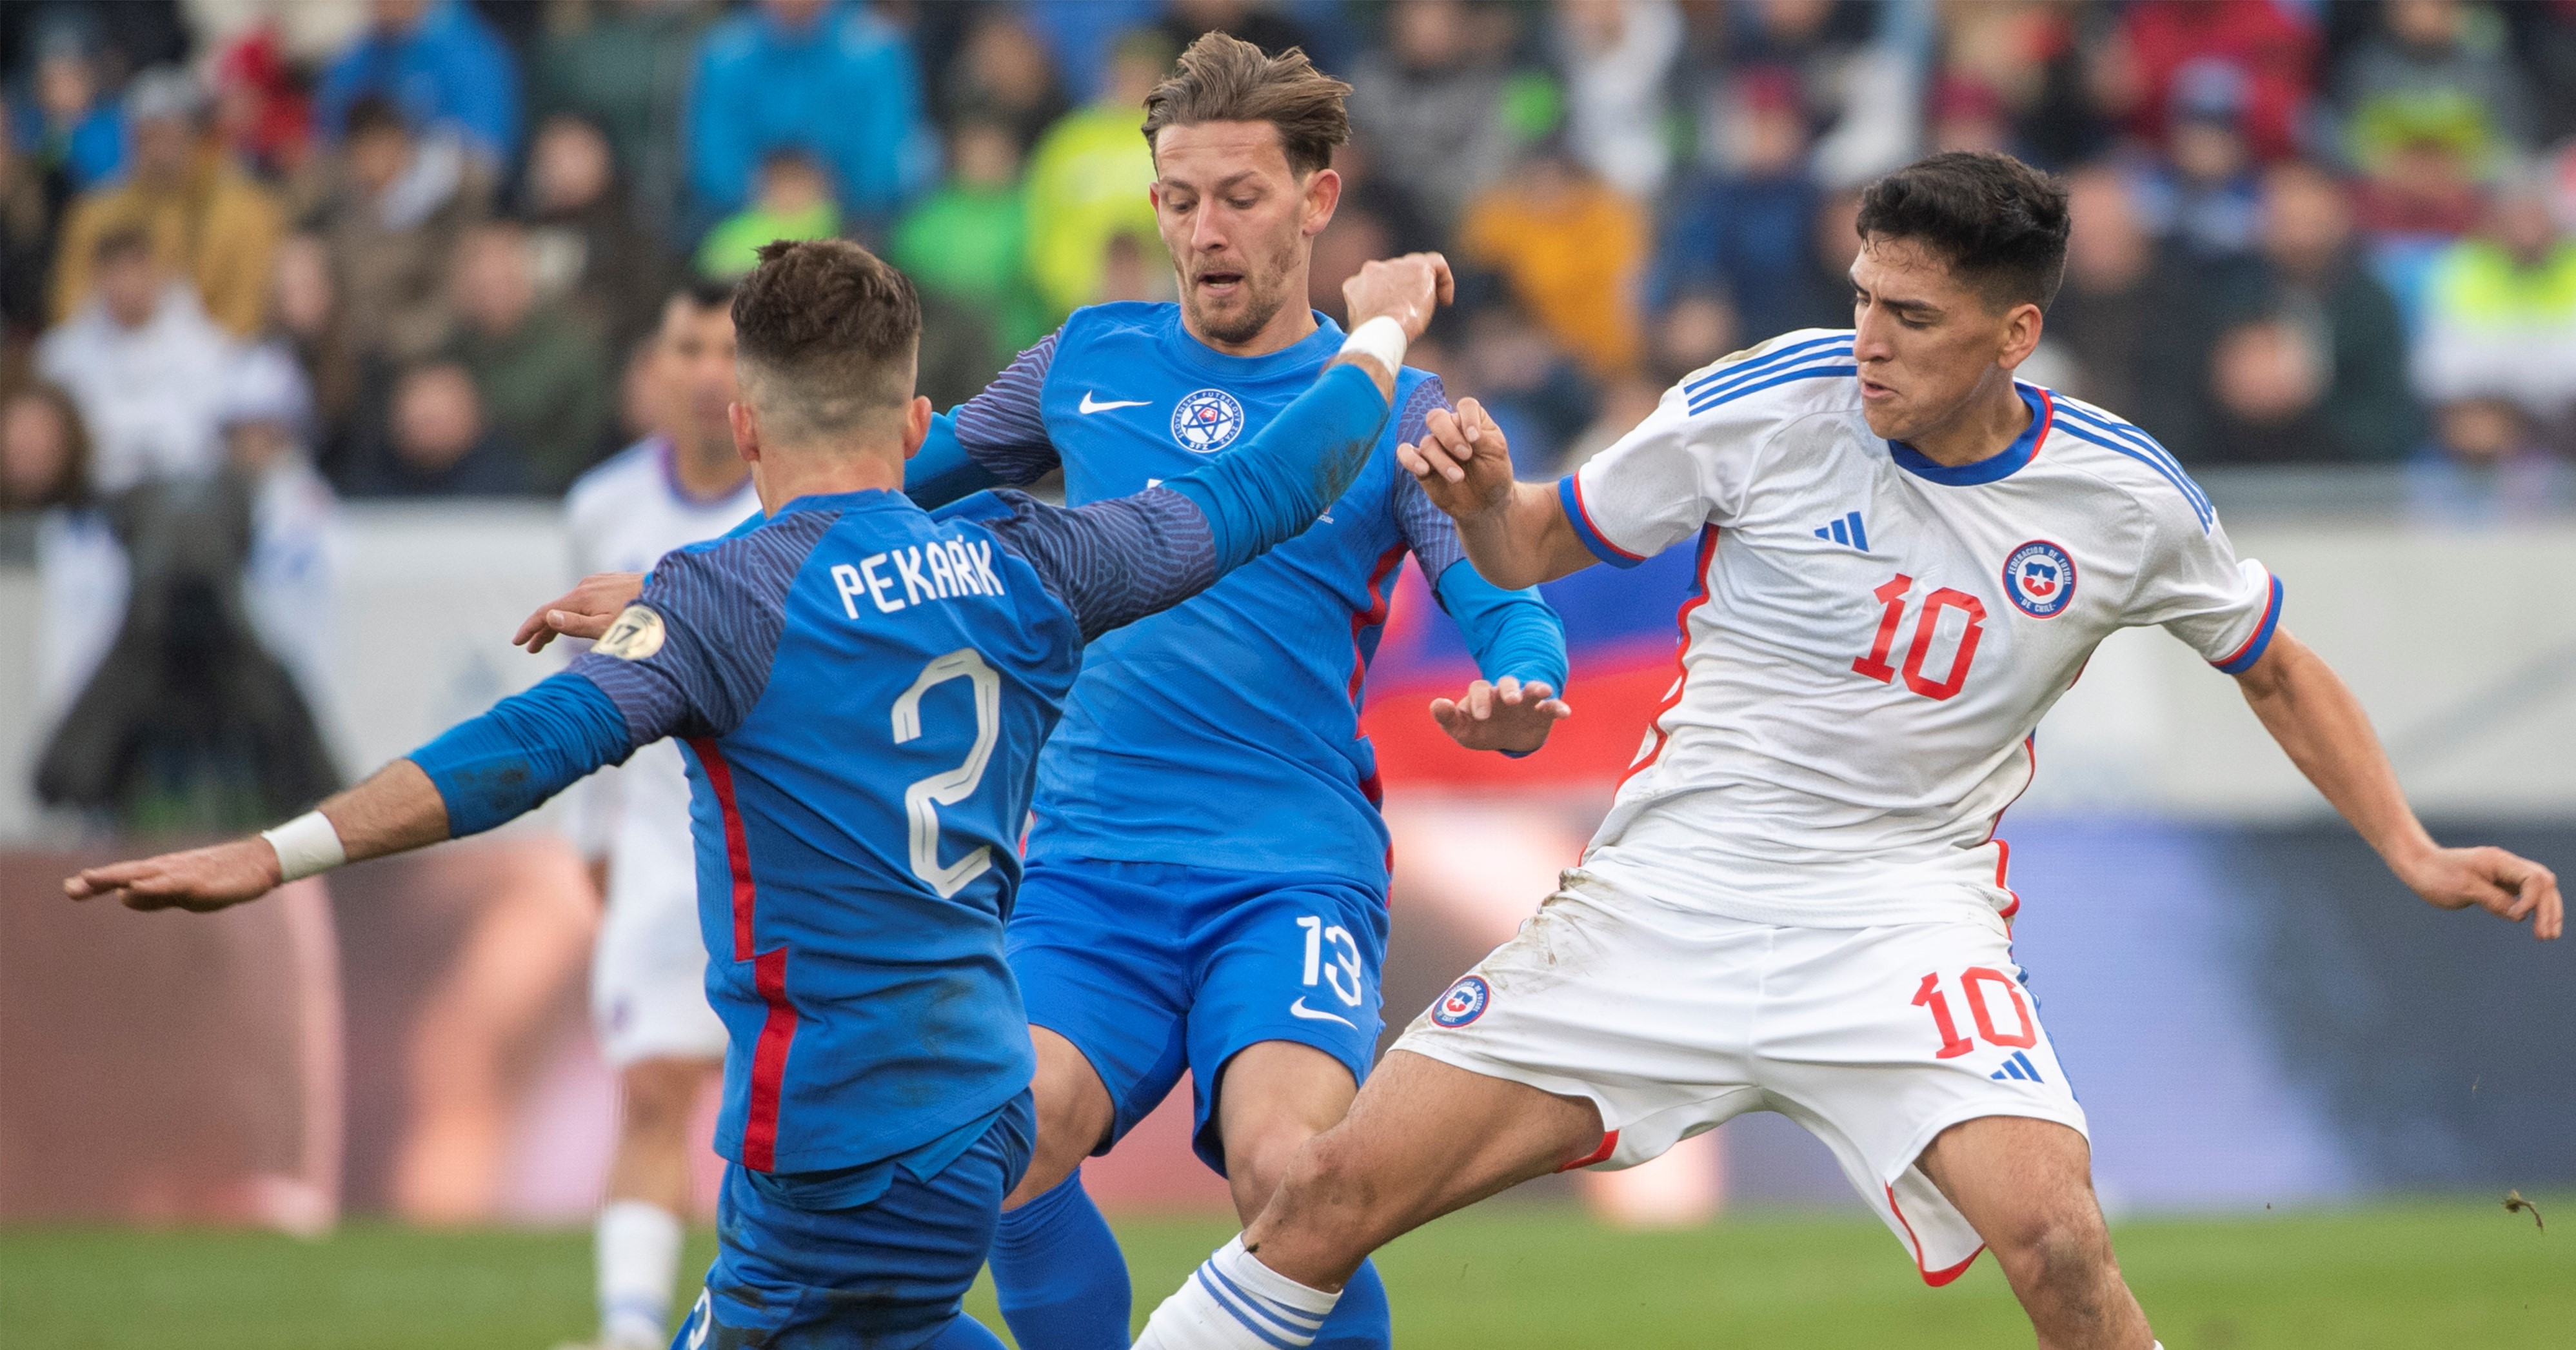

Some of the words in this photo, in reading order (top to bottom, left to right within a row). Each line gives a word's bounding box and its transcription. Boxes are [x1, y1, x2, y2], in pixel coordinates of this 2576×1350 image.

[2048, 549, 2059, 559] DE
[1850, 572, 1988, 702] 10
[2021, 599, 2032, 610] DE
[891, 647, 1001, 900] 2
[1296, 915, 1362, 1007] 13
[1910, 966, 2037, 1059] 10
